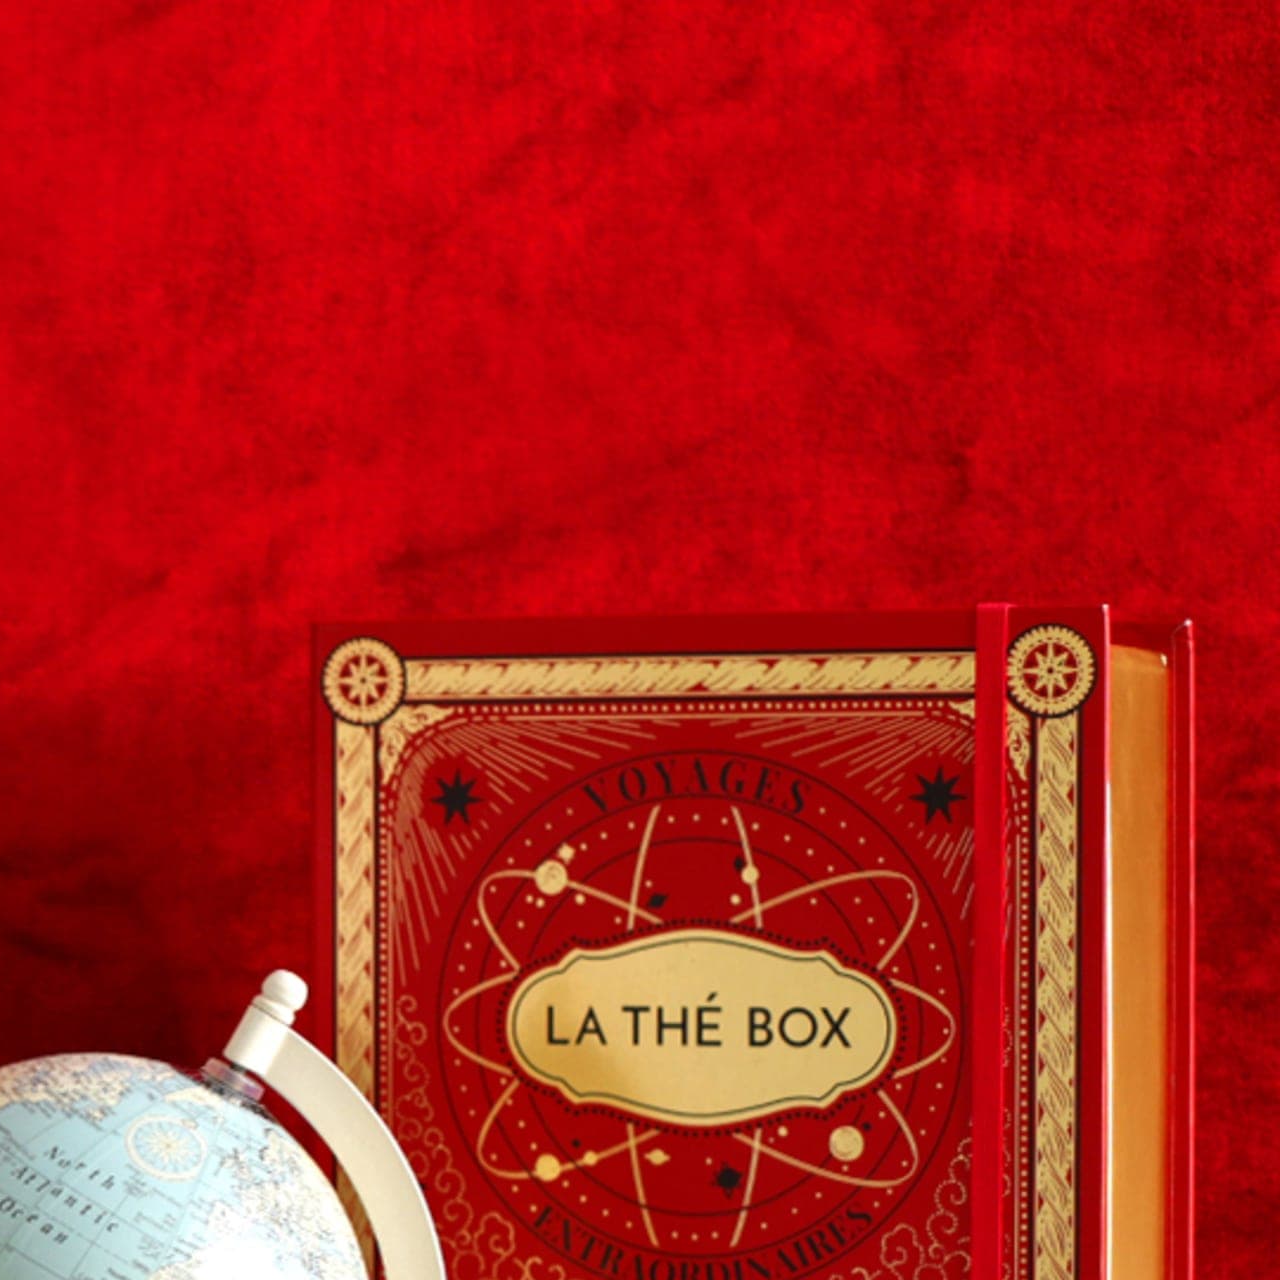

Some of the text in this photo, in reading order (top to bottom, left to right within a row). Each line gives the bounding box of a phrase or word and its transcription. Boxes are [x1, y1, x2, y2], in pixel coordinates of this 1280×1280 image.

[582, 757, 814, 815] VOYAGES
[546, 991, 852, 1048] LA THÉ BOX
[43, 1145, 115, 1190] North
[10, 1166, 119, 1232] Atlantic
